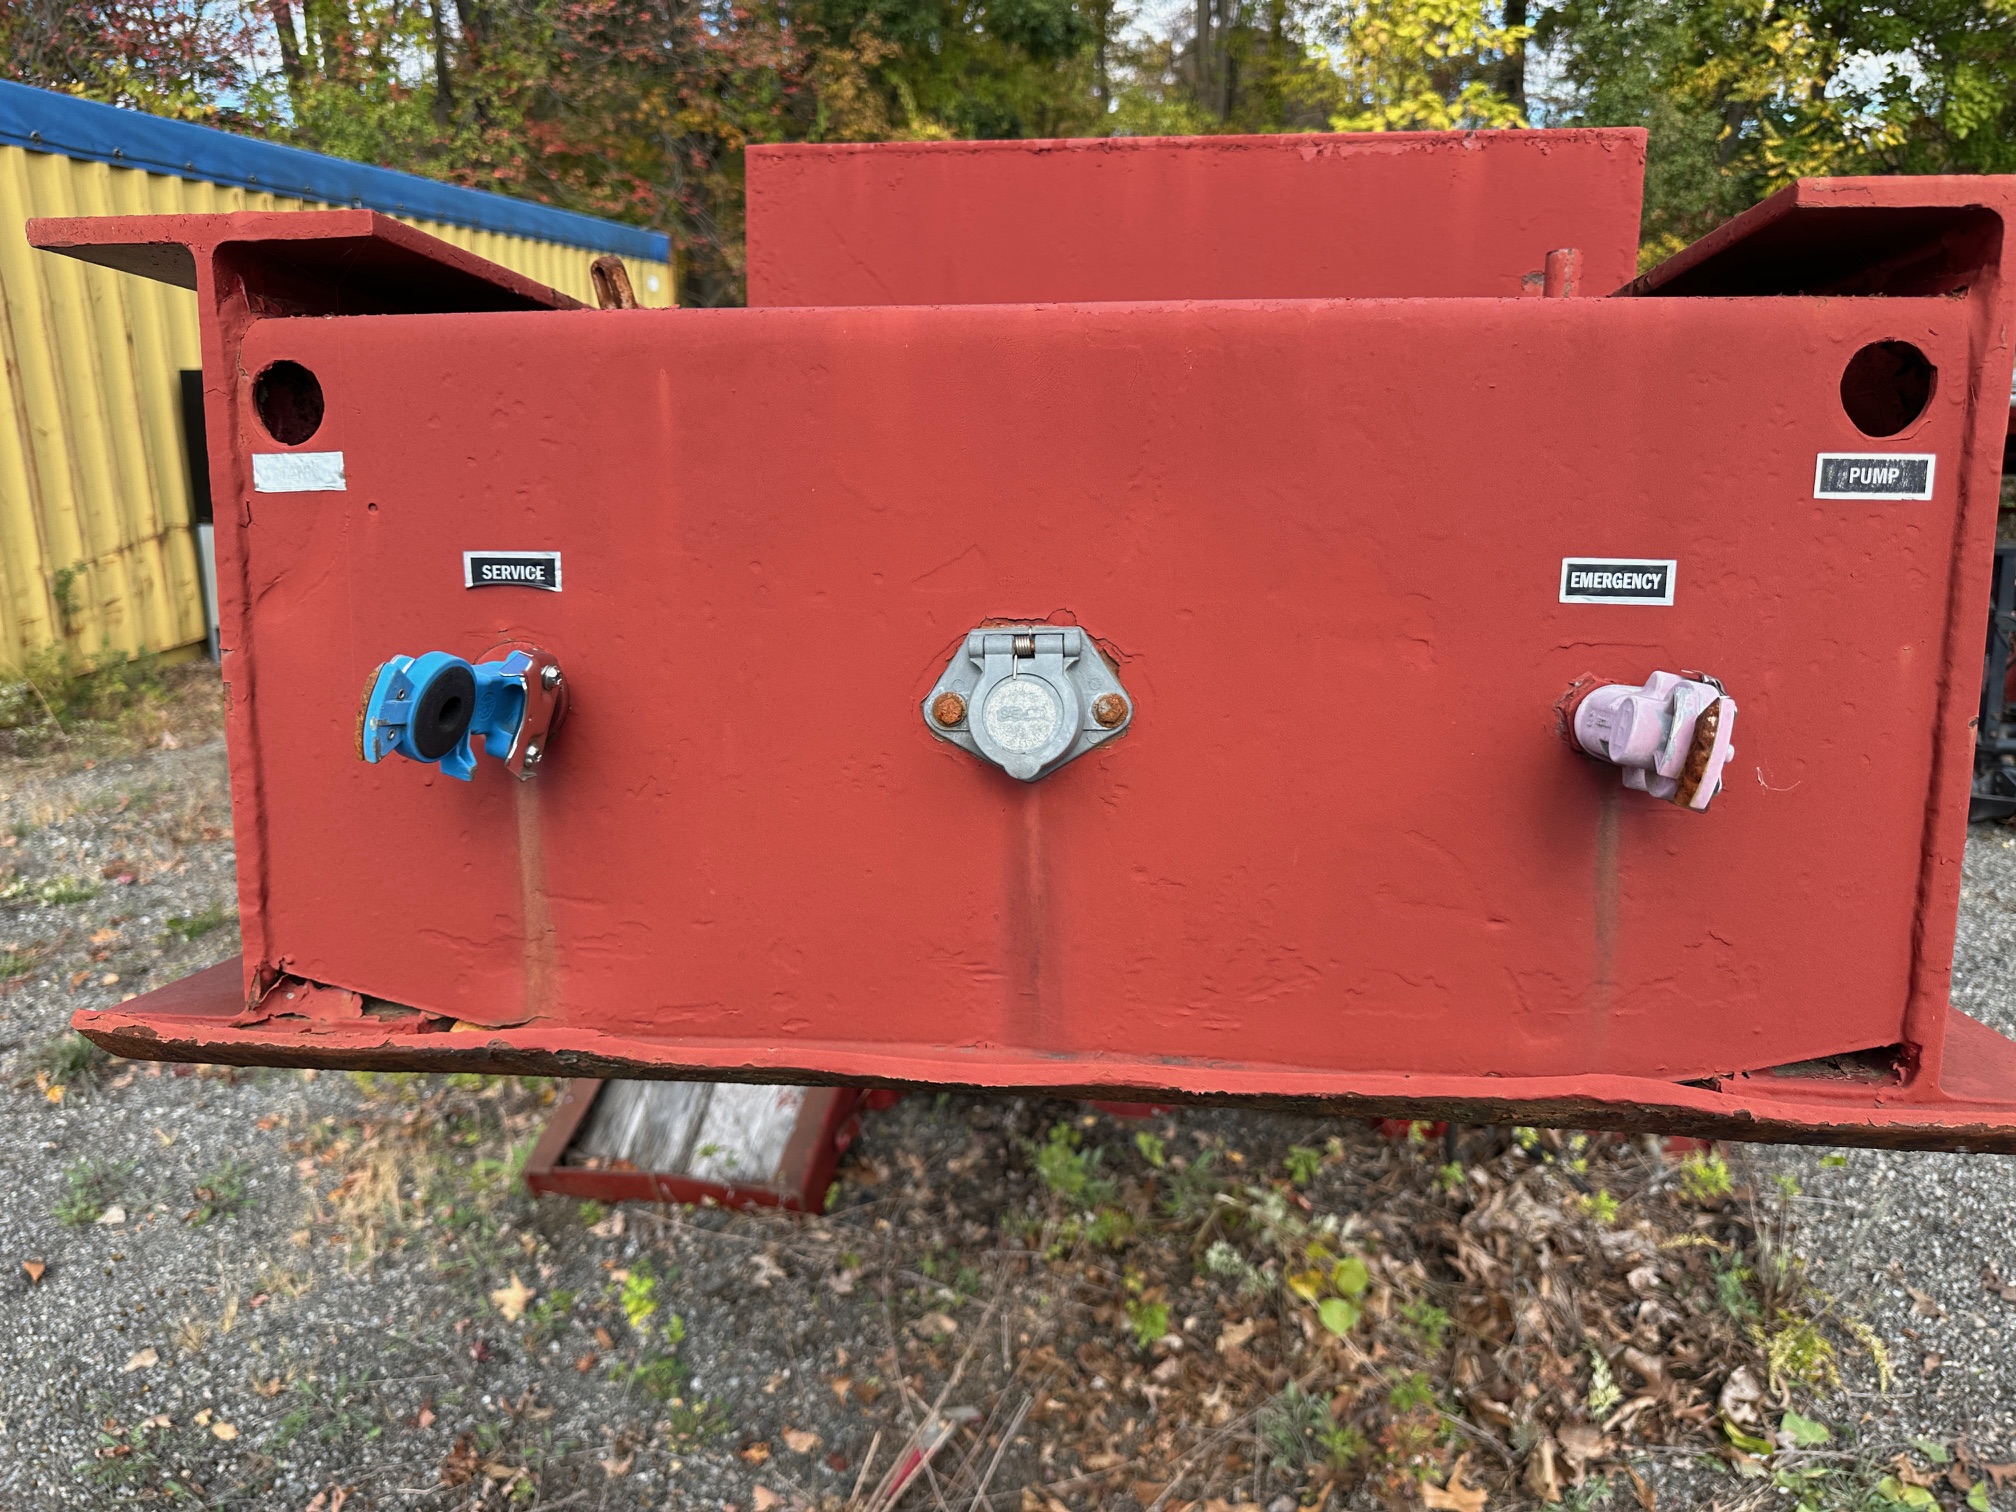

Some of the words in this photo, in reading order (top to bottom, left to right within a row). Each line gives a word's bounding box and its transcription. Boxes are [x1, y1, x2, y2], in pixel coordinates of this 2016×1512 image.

[1849, 467, 1899, 484] PUMP
[482, 565, 545, 580] SERVICE
[1570, 572, 1662, 590] EMERGENCY
